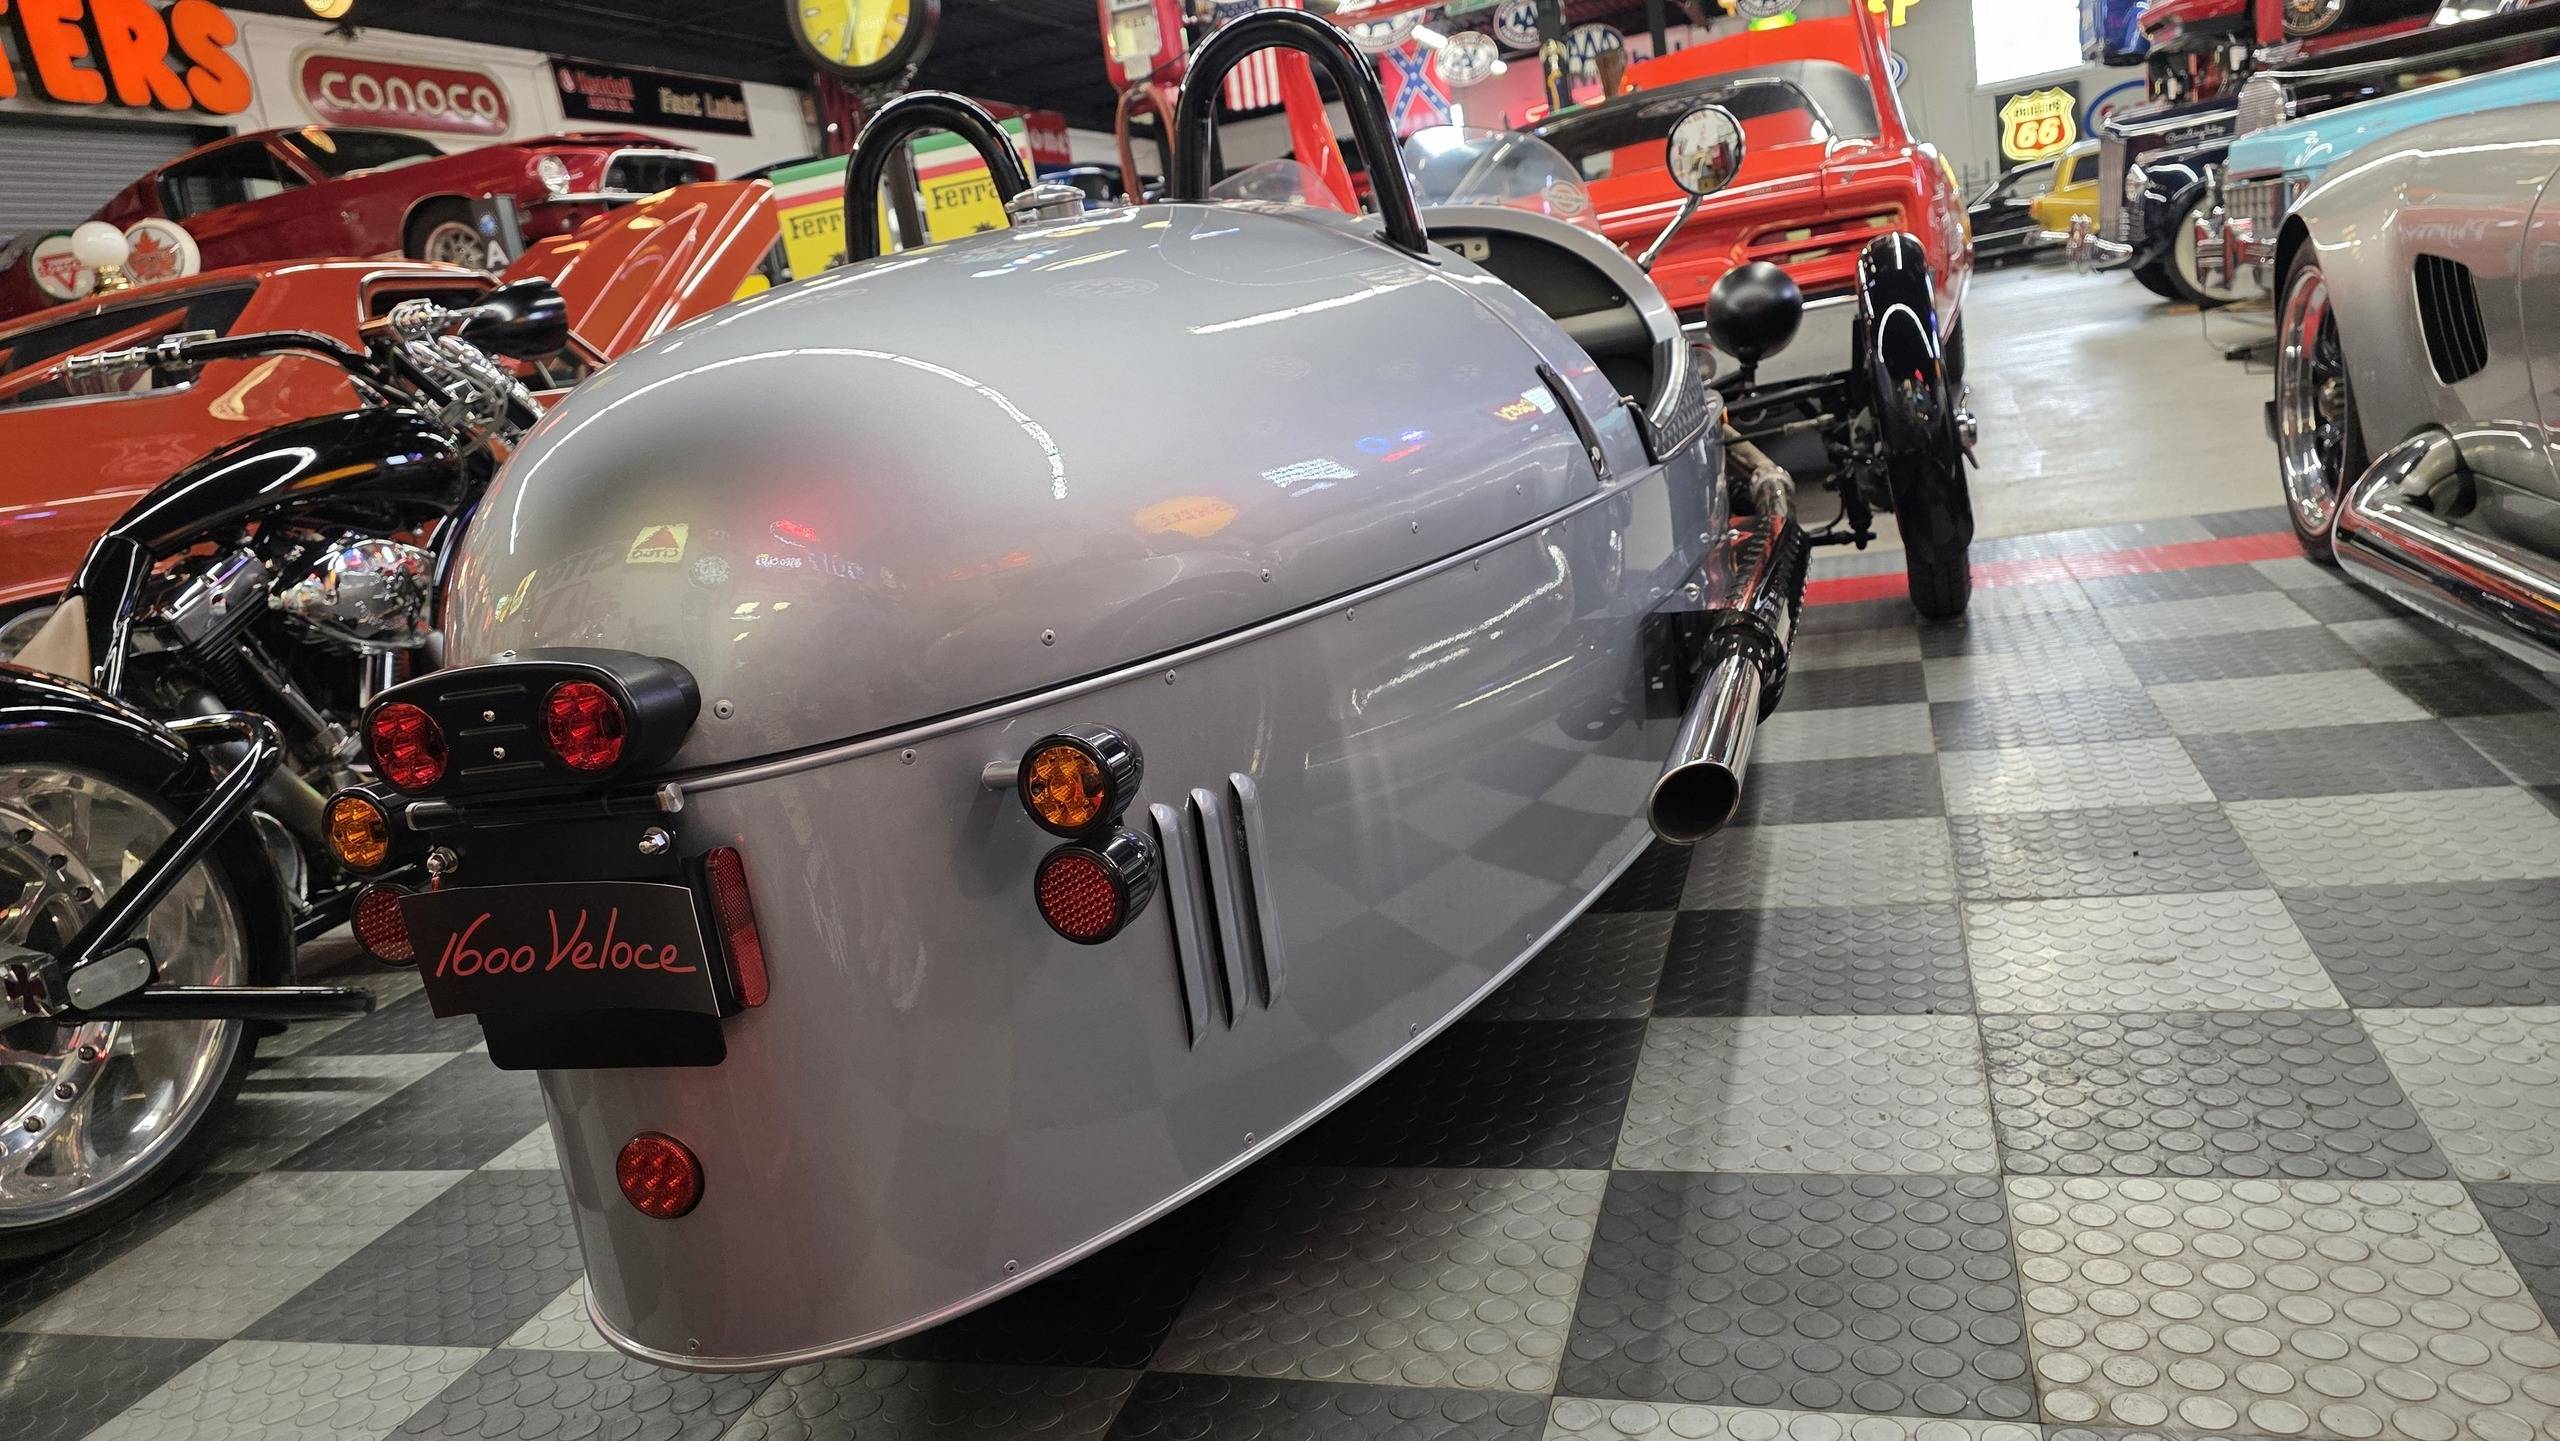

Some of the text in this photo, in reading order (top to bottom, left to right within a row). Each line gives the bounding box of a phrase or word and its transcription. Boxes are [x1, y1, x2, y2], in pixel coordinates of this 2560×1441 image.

[0, 0, 253, 114] ERS
[2016, 115, 2061, 149] 66
[931, 176, 998, 210] Ferra
[788, 207, 844, 239] Ferr
[435, 907, 696, 977] 1600 Veloce
